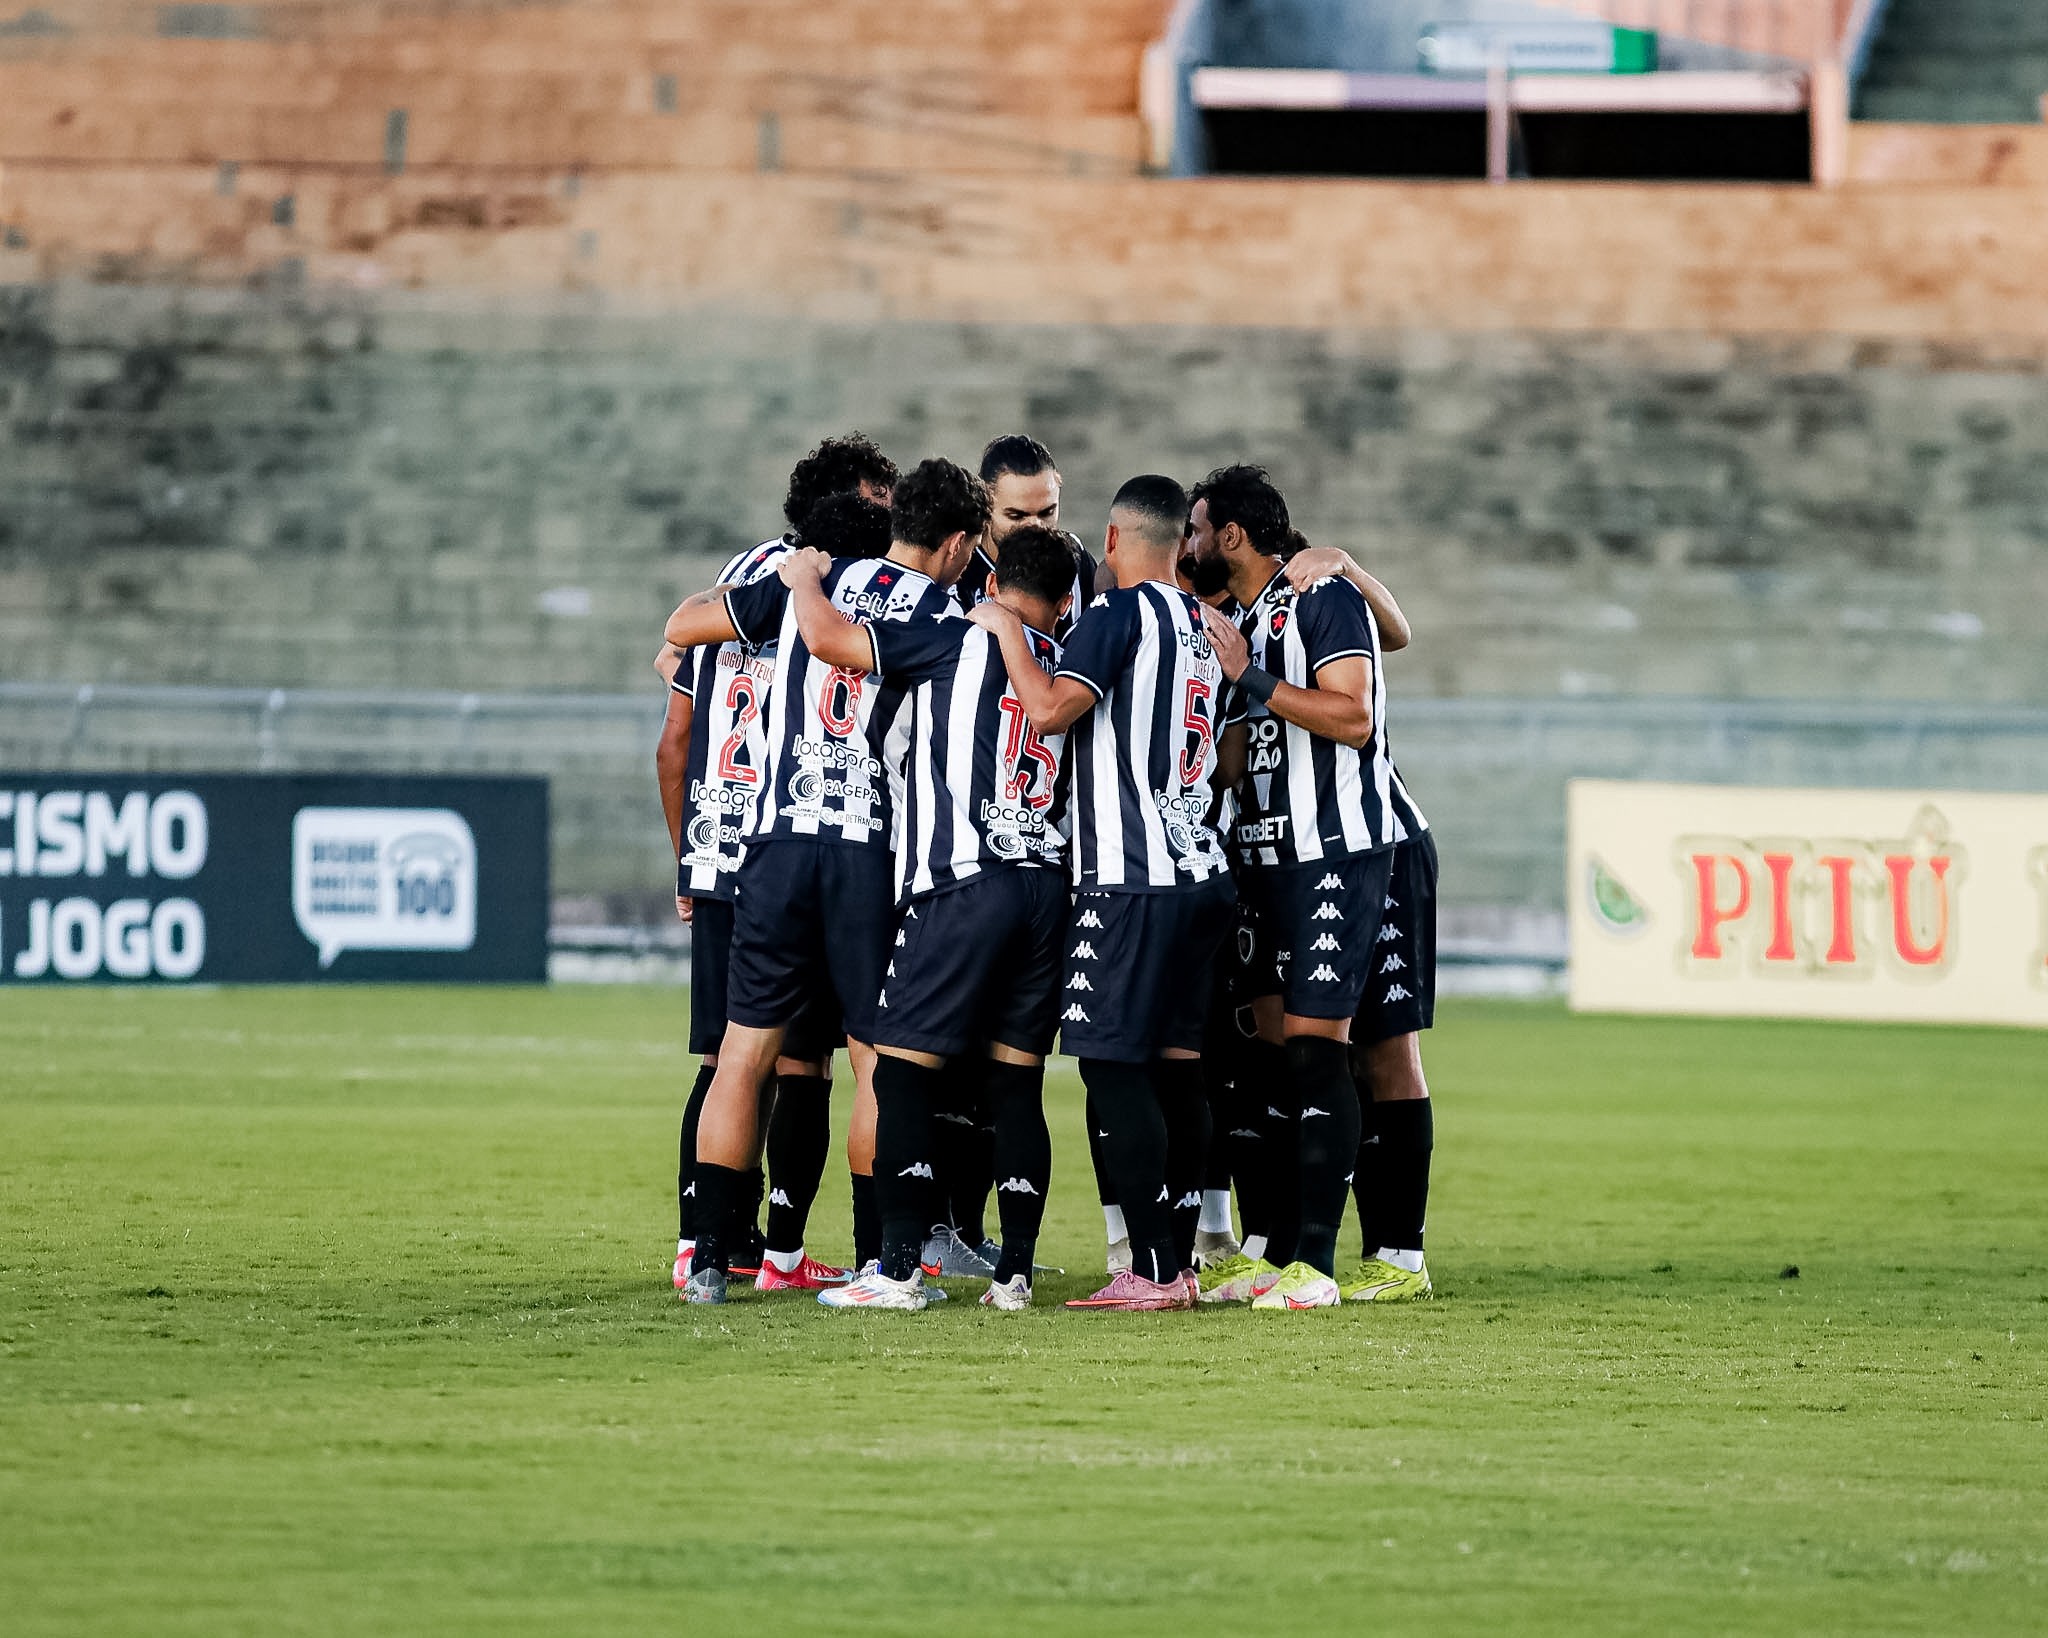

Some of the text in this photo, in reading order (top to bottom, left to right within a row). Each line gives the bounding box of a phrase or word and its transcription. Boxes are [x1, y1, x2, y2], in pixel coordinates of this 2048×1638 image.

[841, 585, 890, 619] tely
[717, 651, 743, 669] DIOGO
[1178, 626, 1212, 660] tely
[717, 676, 759, 783] 2
[1180, 678, 1212, 786] 5
[793, 736, 881, 776] locagora
[1000, 696, 1058, 809] 15
[824, 780, 881, 806] CAGEPA
[13, 896, 207, 978] JOGO
